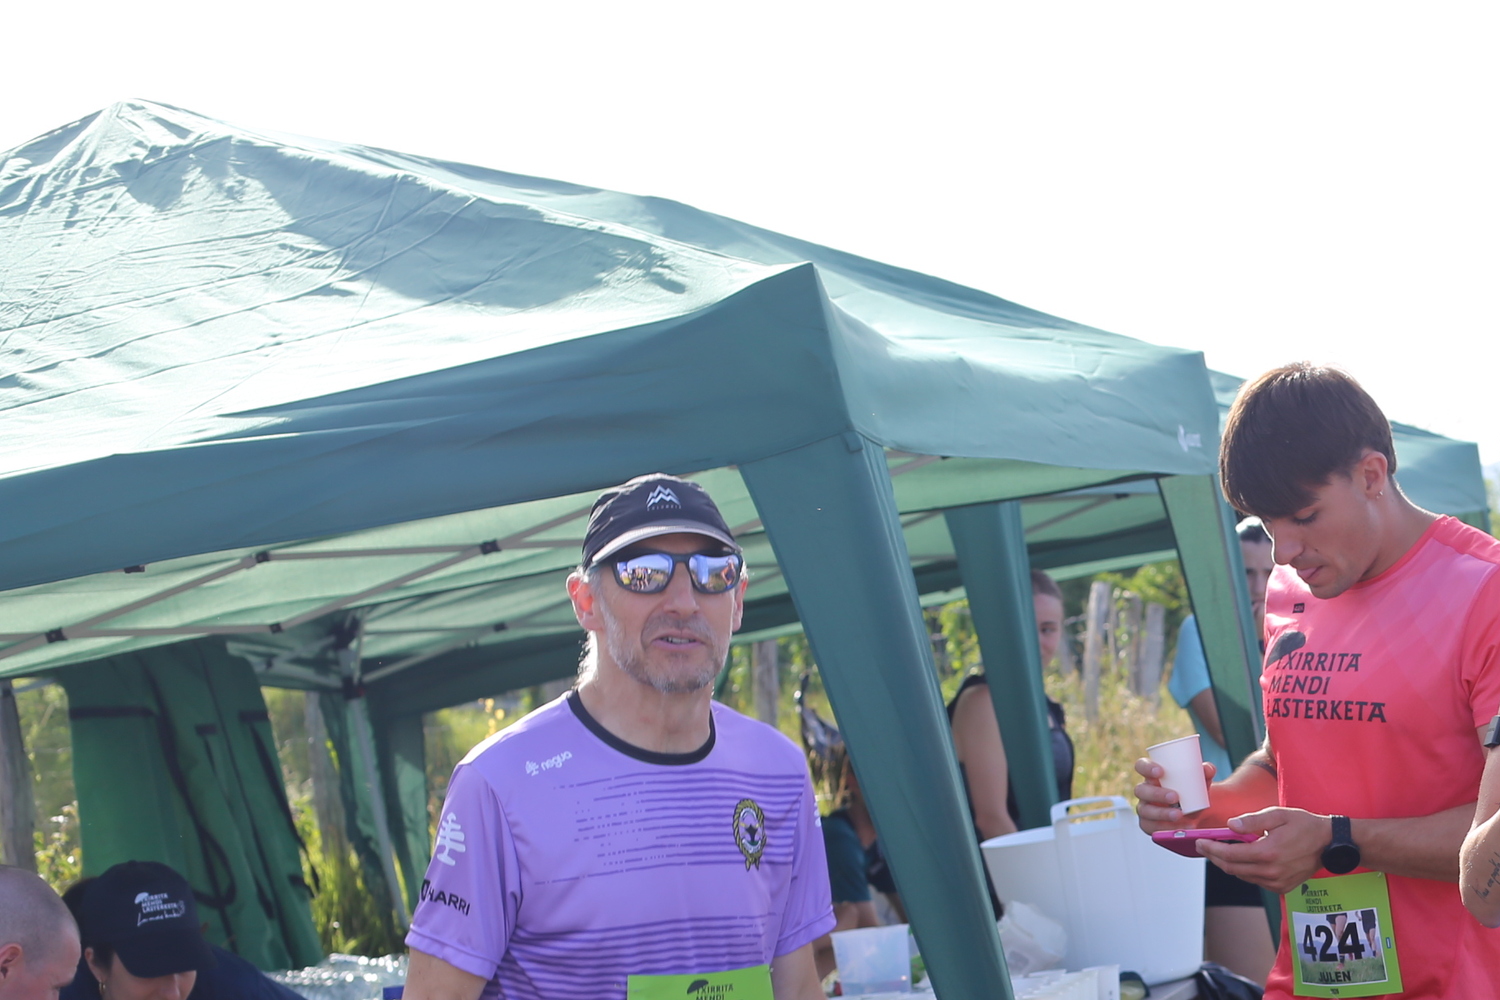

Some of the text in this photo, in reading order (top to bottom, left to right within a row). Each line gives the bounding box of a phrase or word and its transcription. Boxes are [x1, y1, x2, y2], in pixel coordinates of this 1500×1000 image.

[1268, 675, 1331, 695] MENDI
[1267, 698, 1387, 723] LASTERKETA
[1303, 922, 1365, 962] 424
[1318, 971, 1352, 983] JULEN
